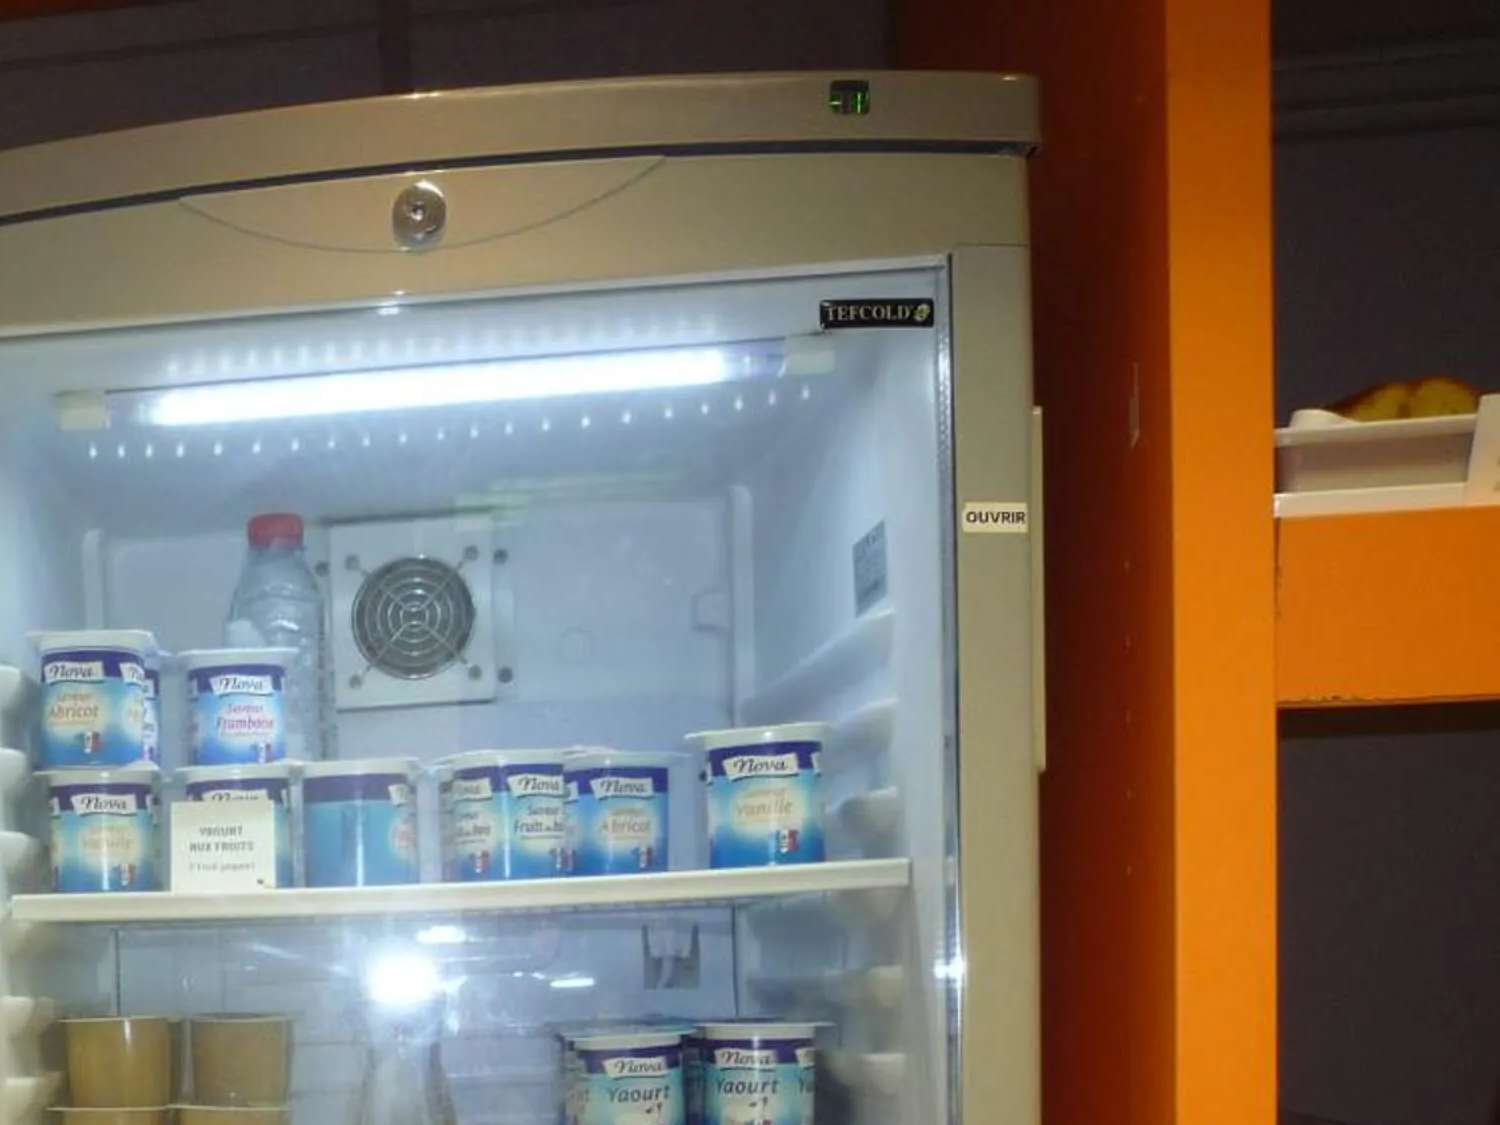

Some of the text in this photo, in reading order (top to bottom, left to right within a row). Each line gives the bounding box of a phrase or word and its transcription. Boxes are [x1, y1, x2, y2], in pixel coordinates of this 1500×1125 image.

[826, 304, 911, 321] TEFCOLD
[965, 511, 1026, 524] OUVRIR
[49, 664, 95, 679] Nova
[219, 677, 264, 690] Nova
[733, 757, 789, 773] Nova
[518, 776, 561, 791] Nova
[601, 779, 647, 793] Nova
[80, 796, 128, 810] Nova
[214, 841, 254, 852] FRUITS
[721, 1050, 772, 1065] Nova
[615, 1060, 663, 1074] Nova
[608, 1084, 670, 1103] Yaourt
[716, 1079, 779, 1094] Yaourt
